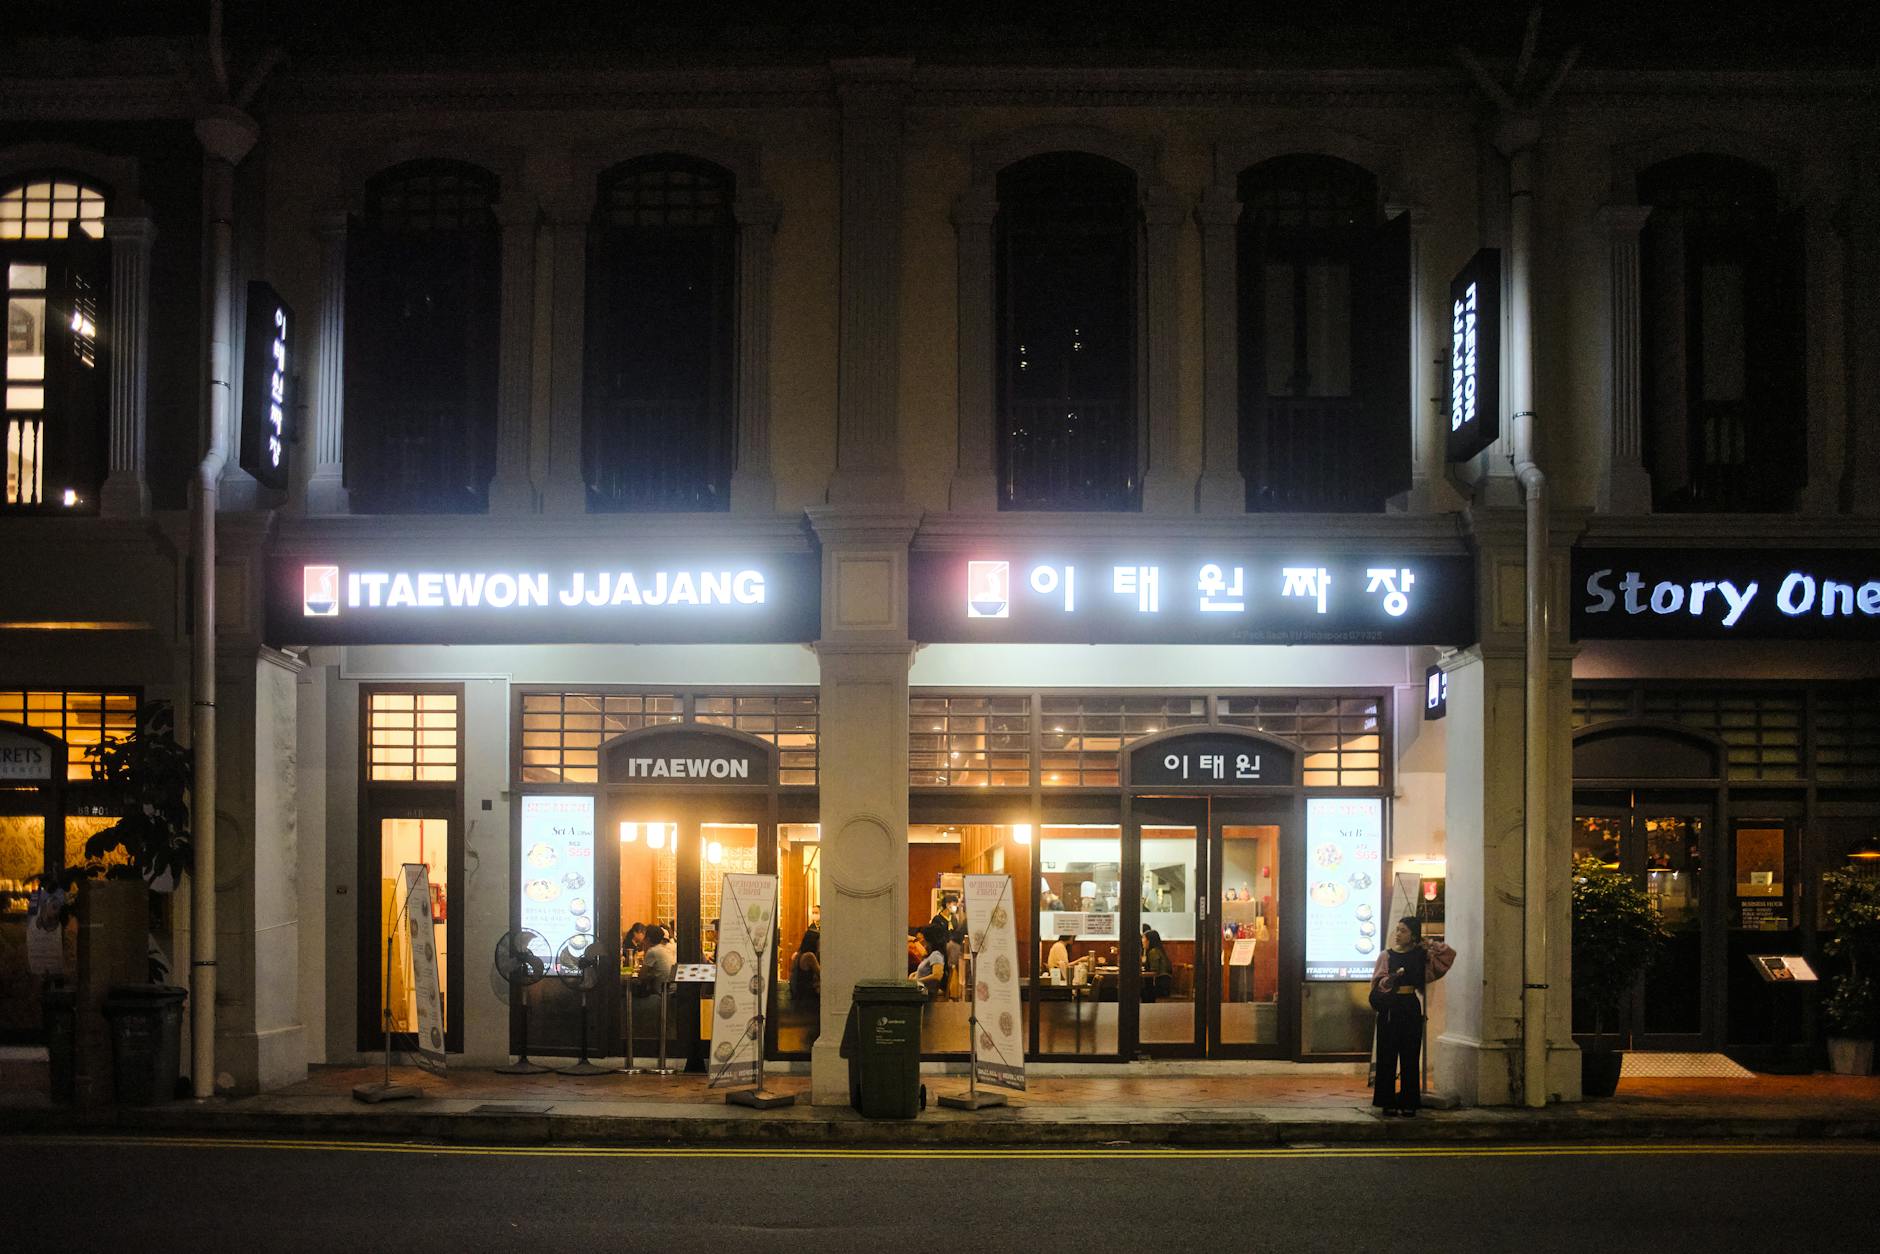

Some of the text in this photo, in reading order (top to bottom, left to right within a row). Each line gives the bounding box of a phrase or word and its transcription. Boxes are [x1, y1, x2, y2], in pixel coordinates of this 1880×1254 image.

[1453, 300, 1465, 431] JJAJANG
[1465, 282, 1476, 422] ITAEWON
[348, 570, 765, 608] ITAEWON JJAJANG
[1584, 568, 1880, 627] Story One
[0, 747, 42, 763] RETS
[628, 757, 749, 778] ITAEWON
[552, 826, 566, 836] Set
[568, 826, 575, 836] A
[1339, 828, 1352, 838] Set
[1355, 828, 1363, 838] B
